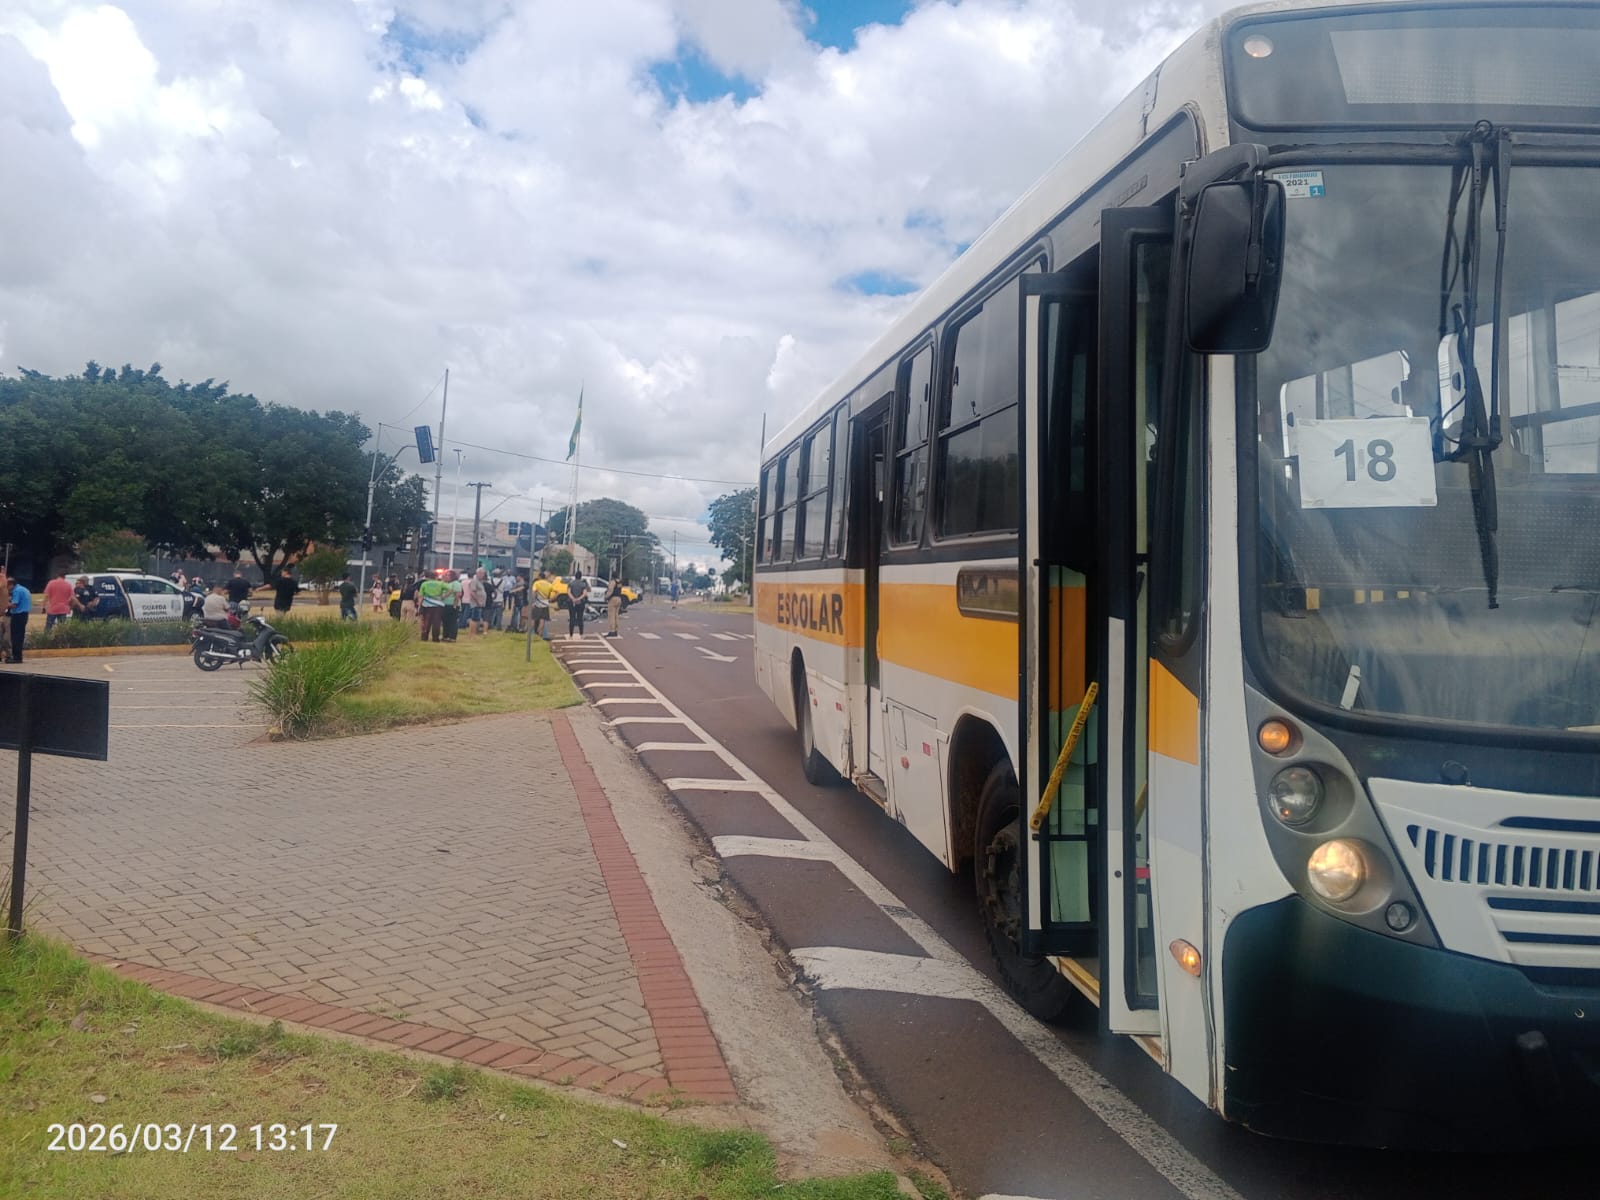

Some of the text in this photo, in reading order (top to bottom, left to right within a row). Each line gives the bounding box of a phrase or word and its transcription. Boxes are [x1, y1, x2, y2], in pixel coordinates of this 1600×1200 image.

[1286, 179, 1309, 187] 2021
[1334, 438, 1397, 482] 18
[777, 592, 844, 636] ESCOLAR
